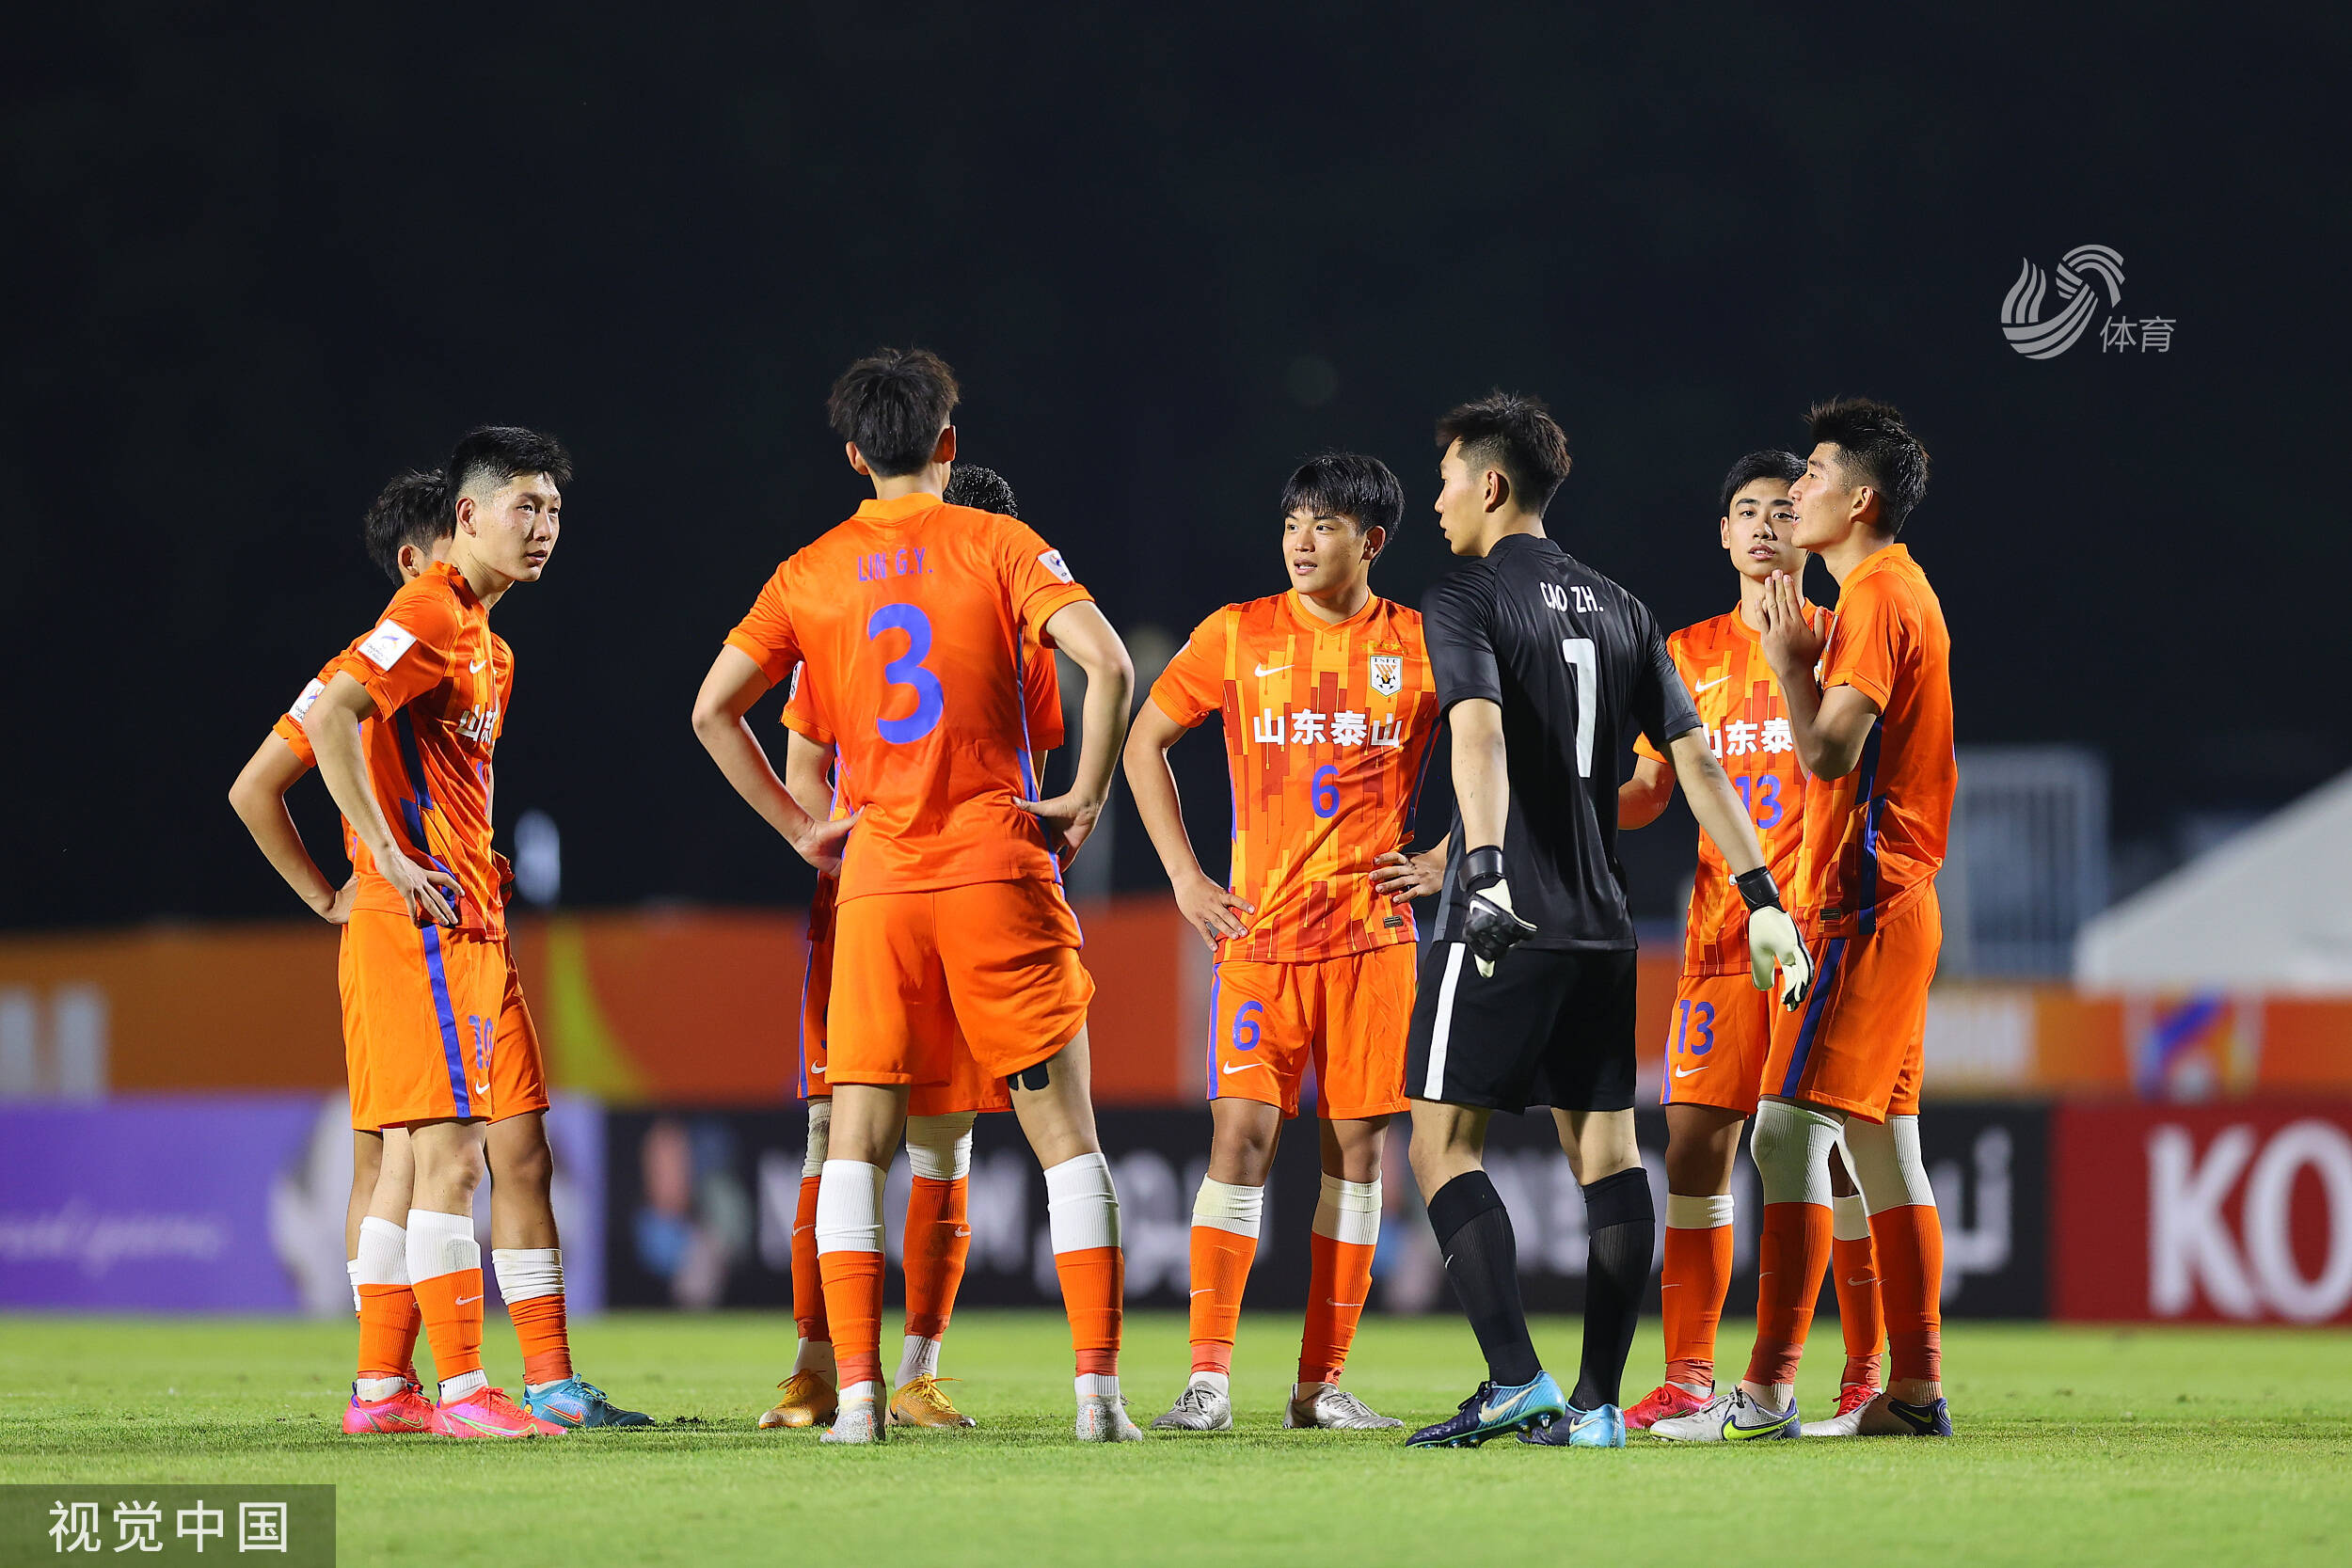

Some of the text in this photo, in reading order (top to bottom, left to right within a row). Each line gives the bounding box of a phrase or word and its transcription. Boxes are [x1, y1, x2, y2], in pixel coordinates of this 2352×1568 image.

[858, 552, 887, 582] LIN
[1539, 580, 1604, 613] CAO ZH.
[868, 603, 945, 745] 3
[1253, 707, 1403, 749] 山东泰山
[1562, 638, 1597, 779] 1
[1311, 765, 1341, 819] 6
[1735, 774, 1784, 830] 13
[1232, 1000, 1264, 1052] 6
[1677, 999, 1715, 1056] 13
